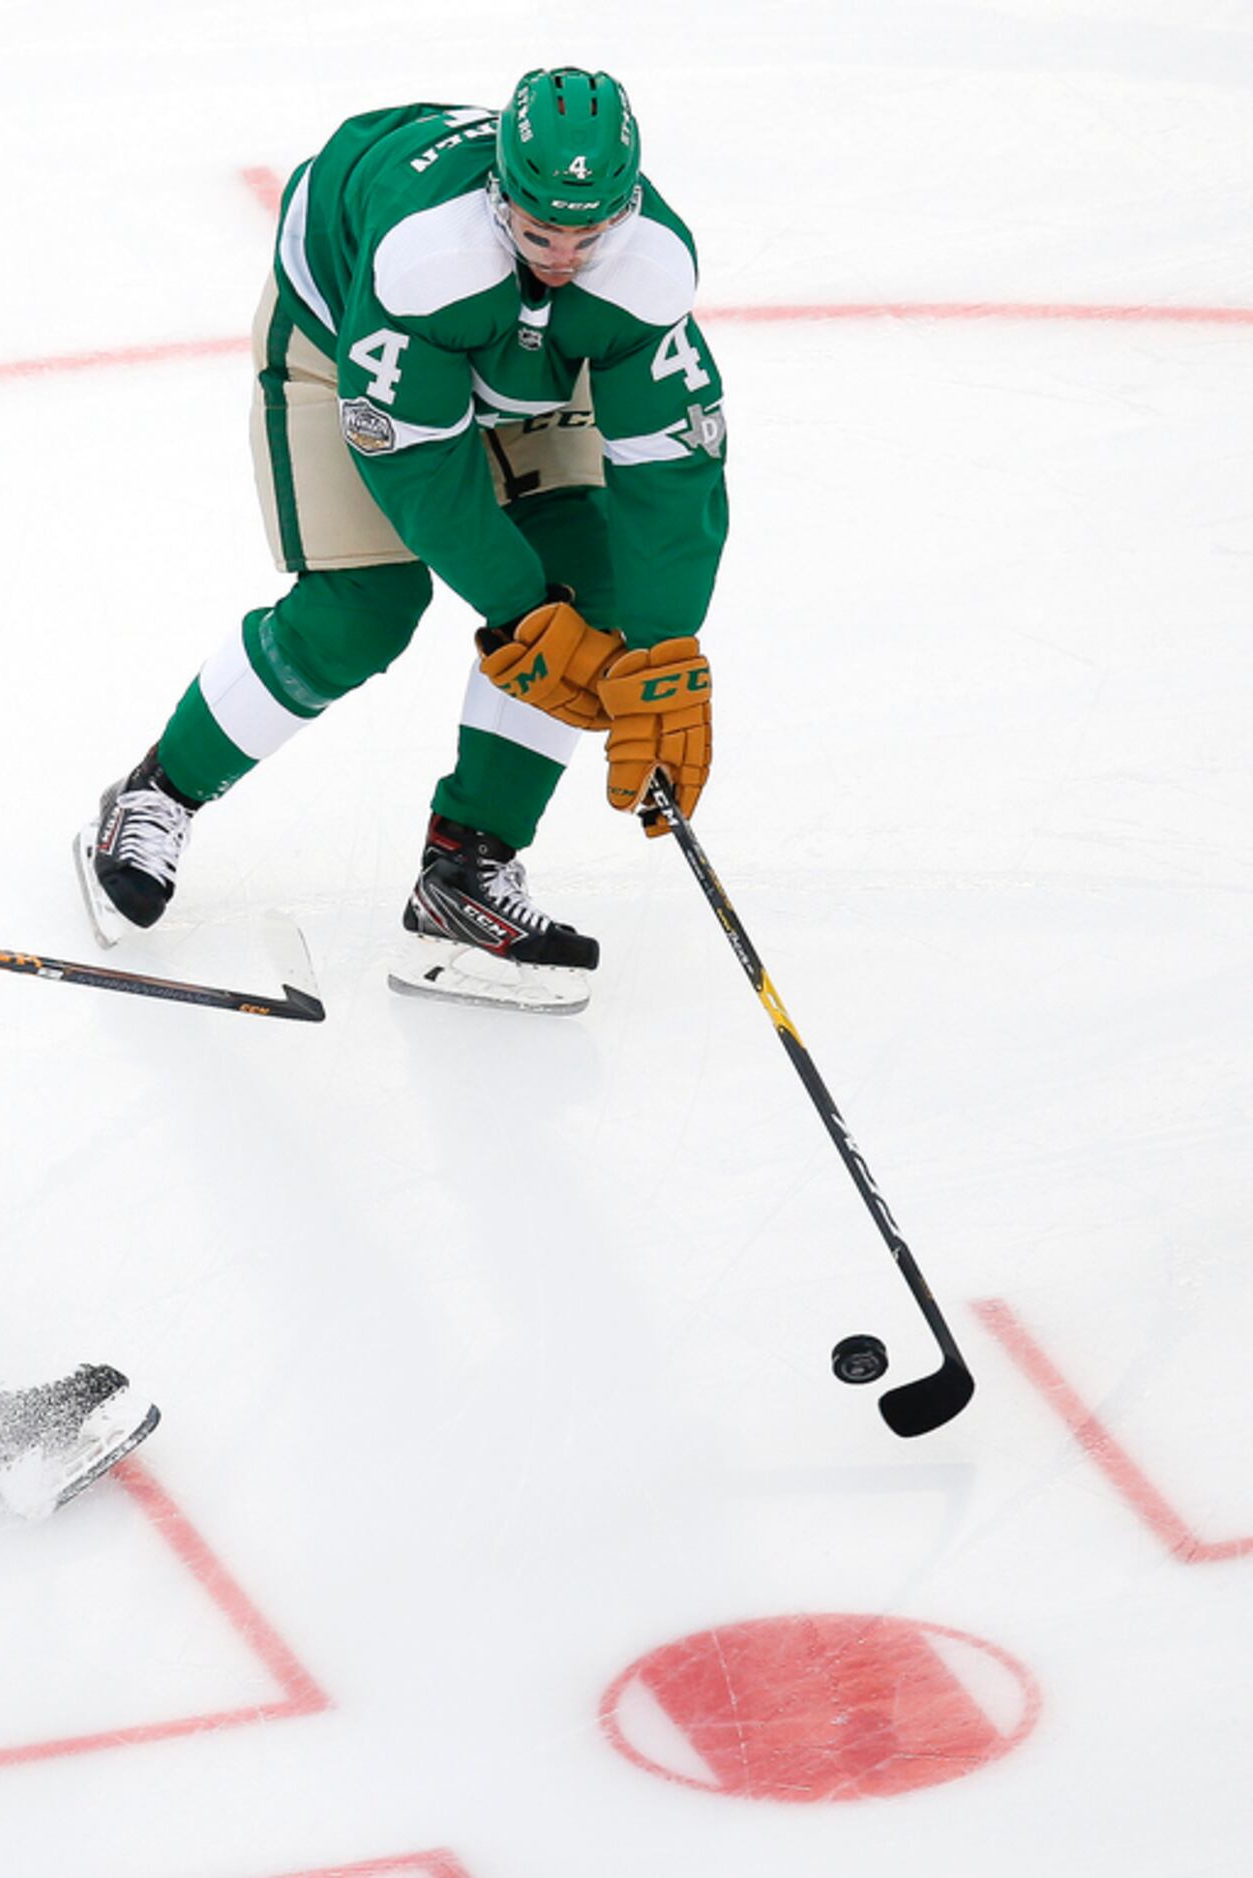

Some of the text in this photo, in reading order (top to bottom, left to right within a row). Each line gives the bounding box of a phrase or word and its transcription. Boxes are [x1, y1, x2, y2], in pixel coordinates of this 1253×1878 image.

[568, 155, 587, 179] 4
[551, 200, 600, 210] CCM
[349, 328, 410, 405] 4
[650, 316, 710, 392] 4
[523, 410, 596, 434] CC
[640, 668, 710, 703] CC
[463, 905, 507, 937] CCM
